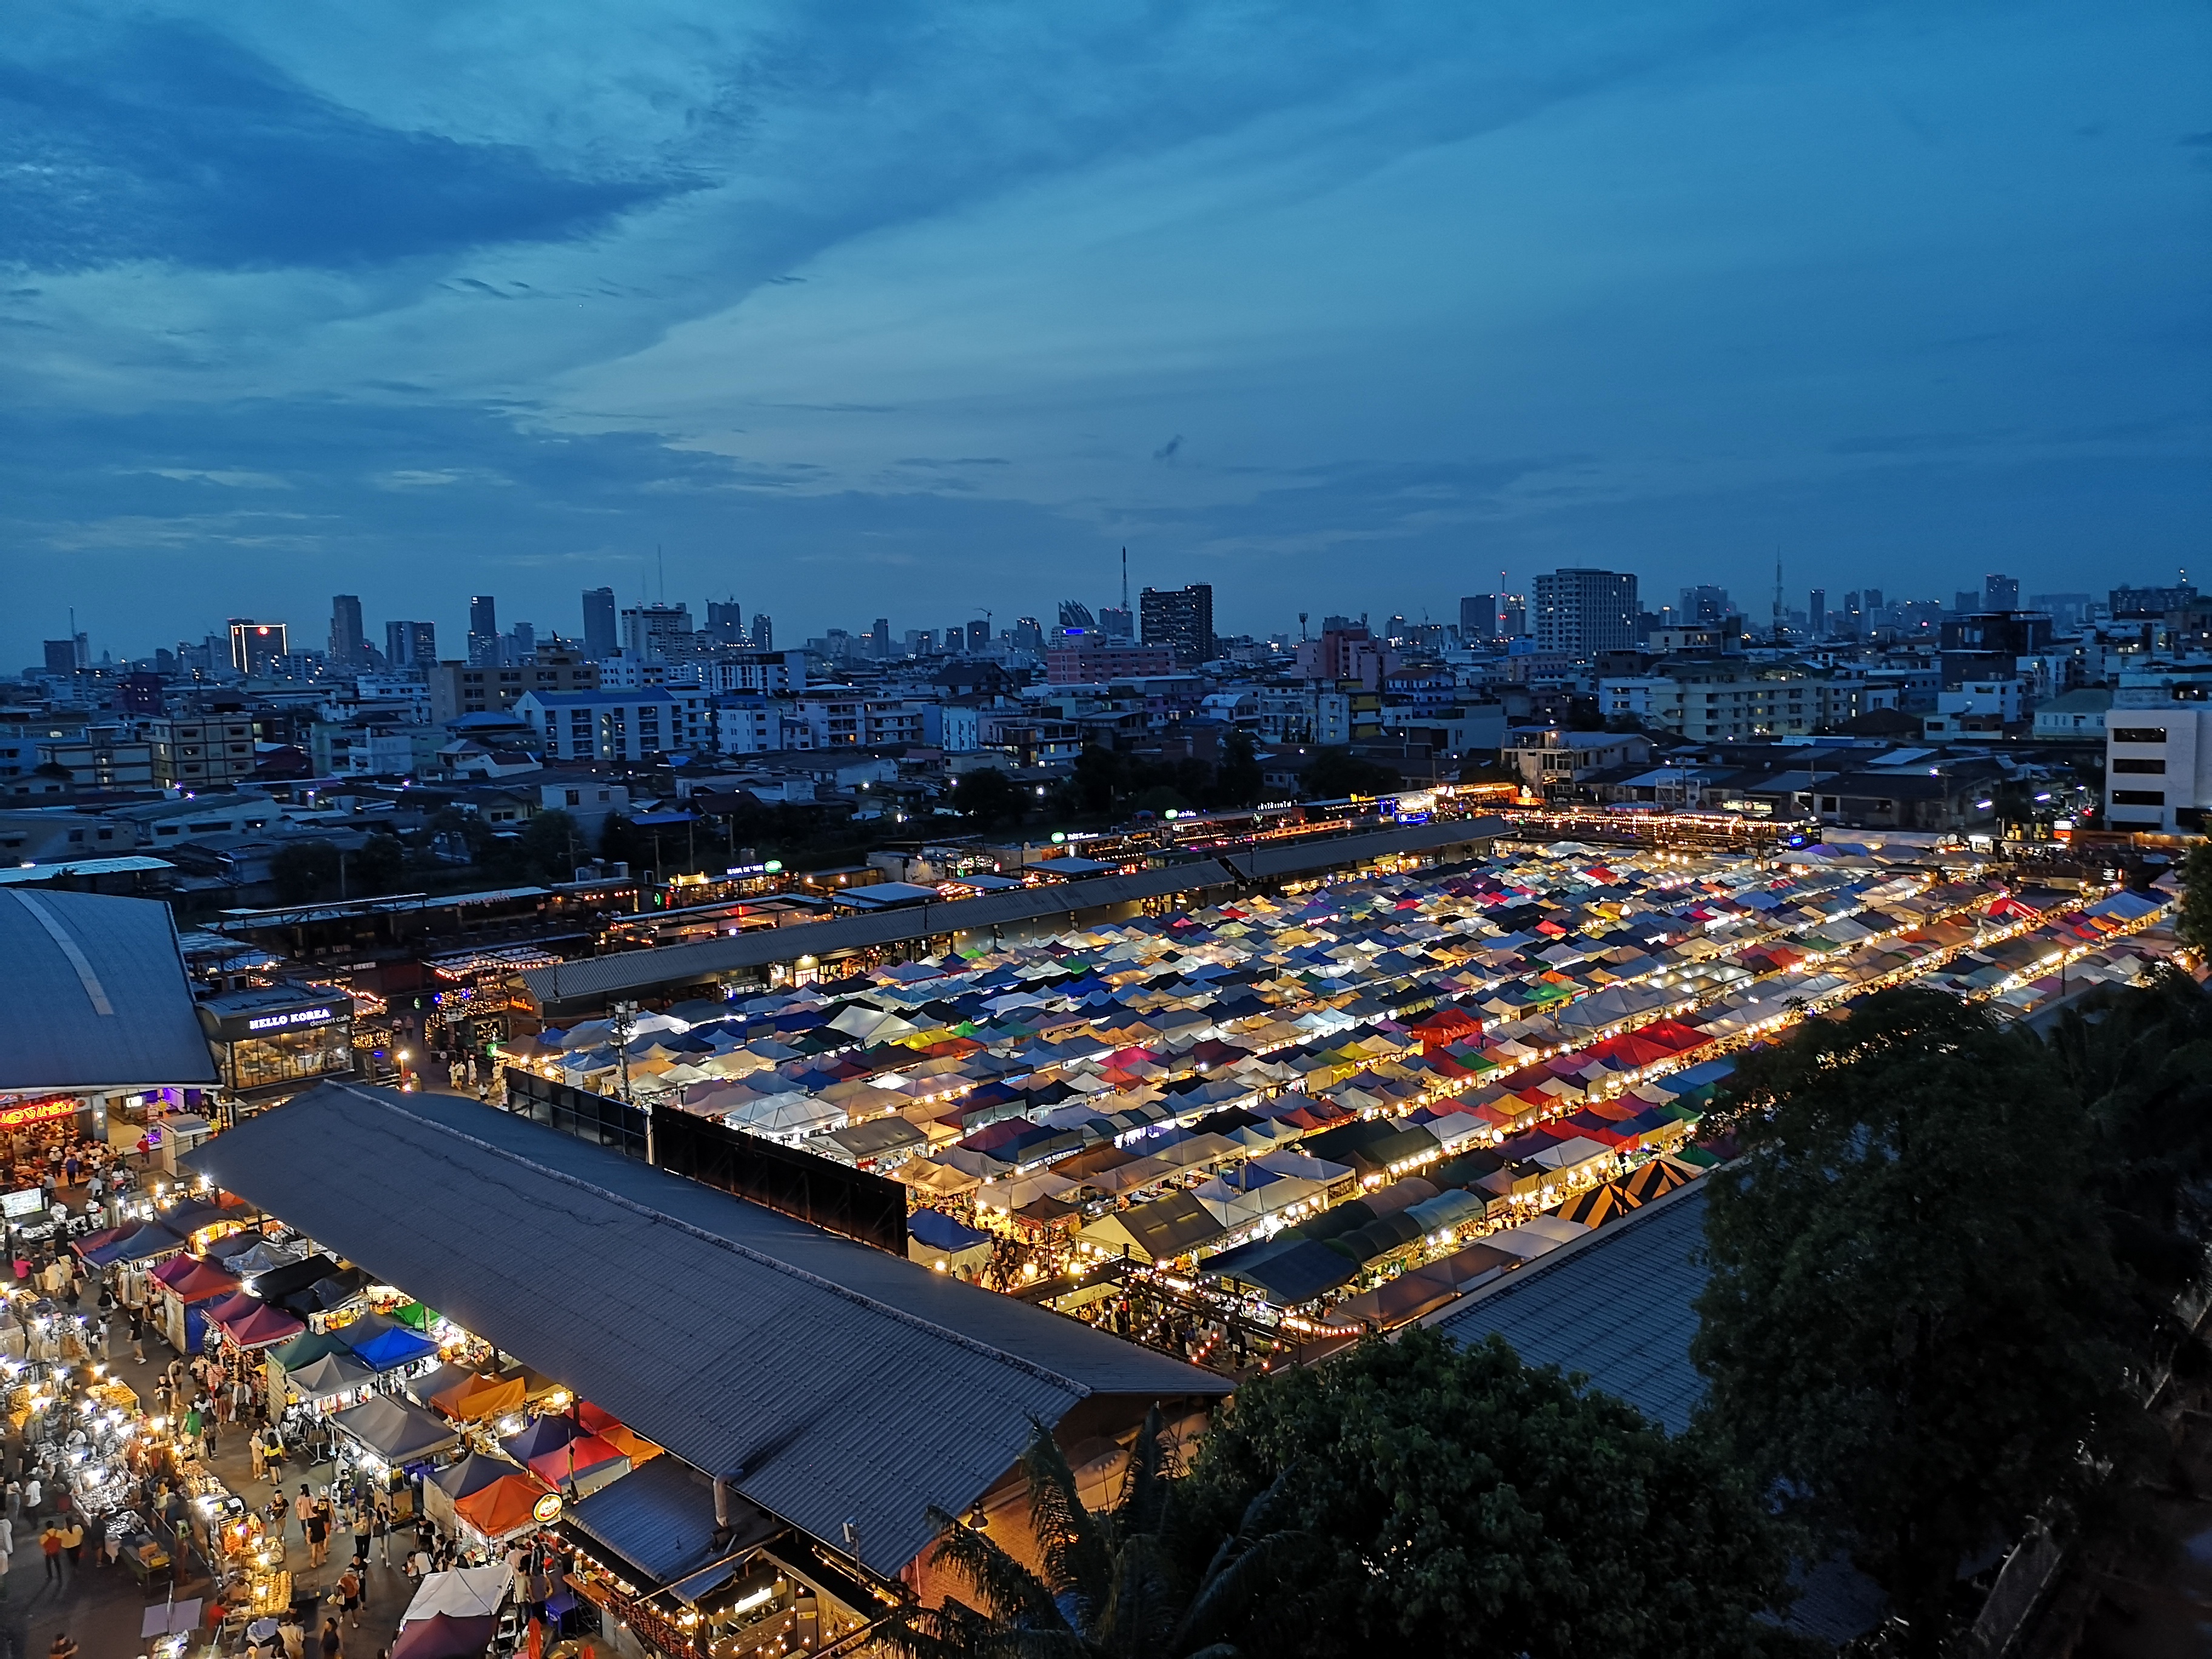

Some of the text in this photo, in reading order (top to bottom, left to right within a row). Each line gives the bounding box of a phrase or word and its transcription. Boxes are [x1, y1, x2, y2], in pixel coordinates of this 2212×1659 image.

[249, 1008, 330, 1030] HELLO KOREA
[309, 1014, 351, 1027] dessert cafe
